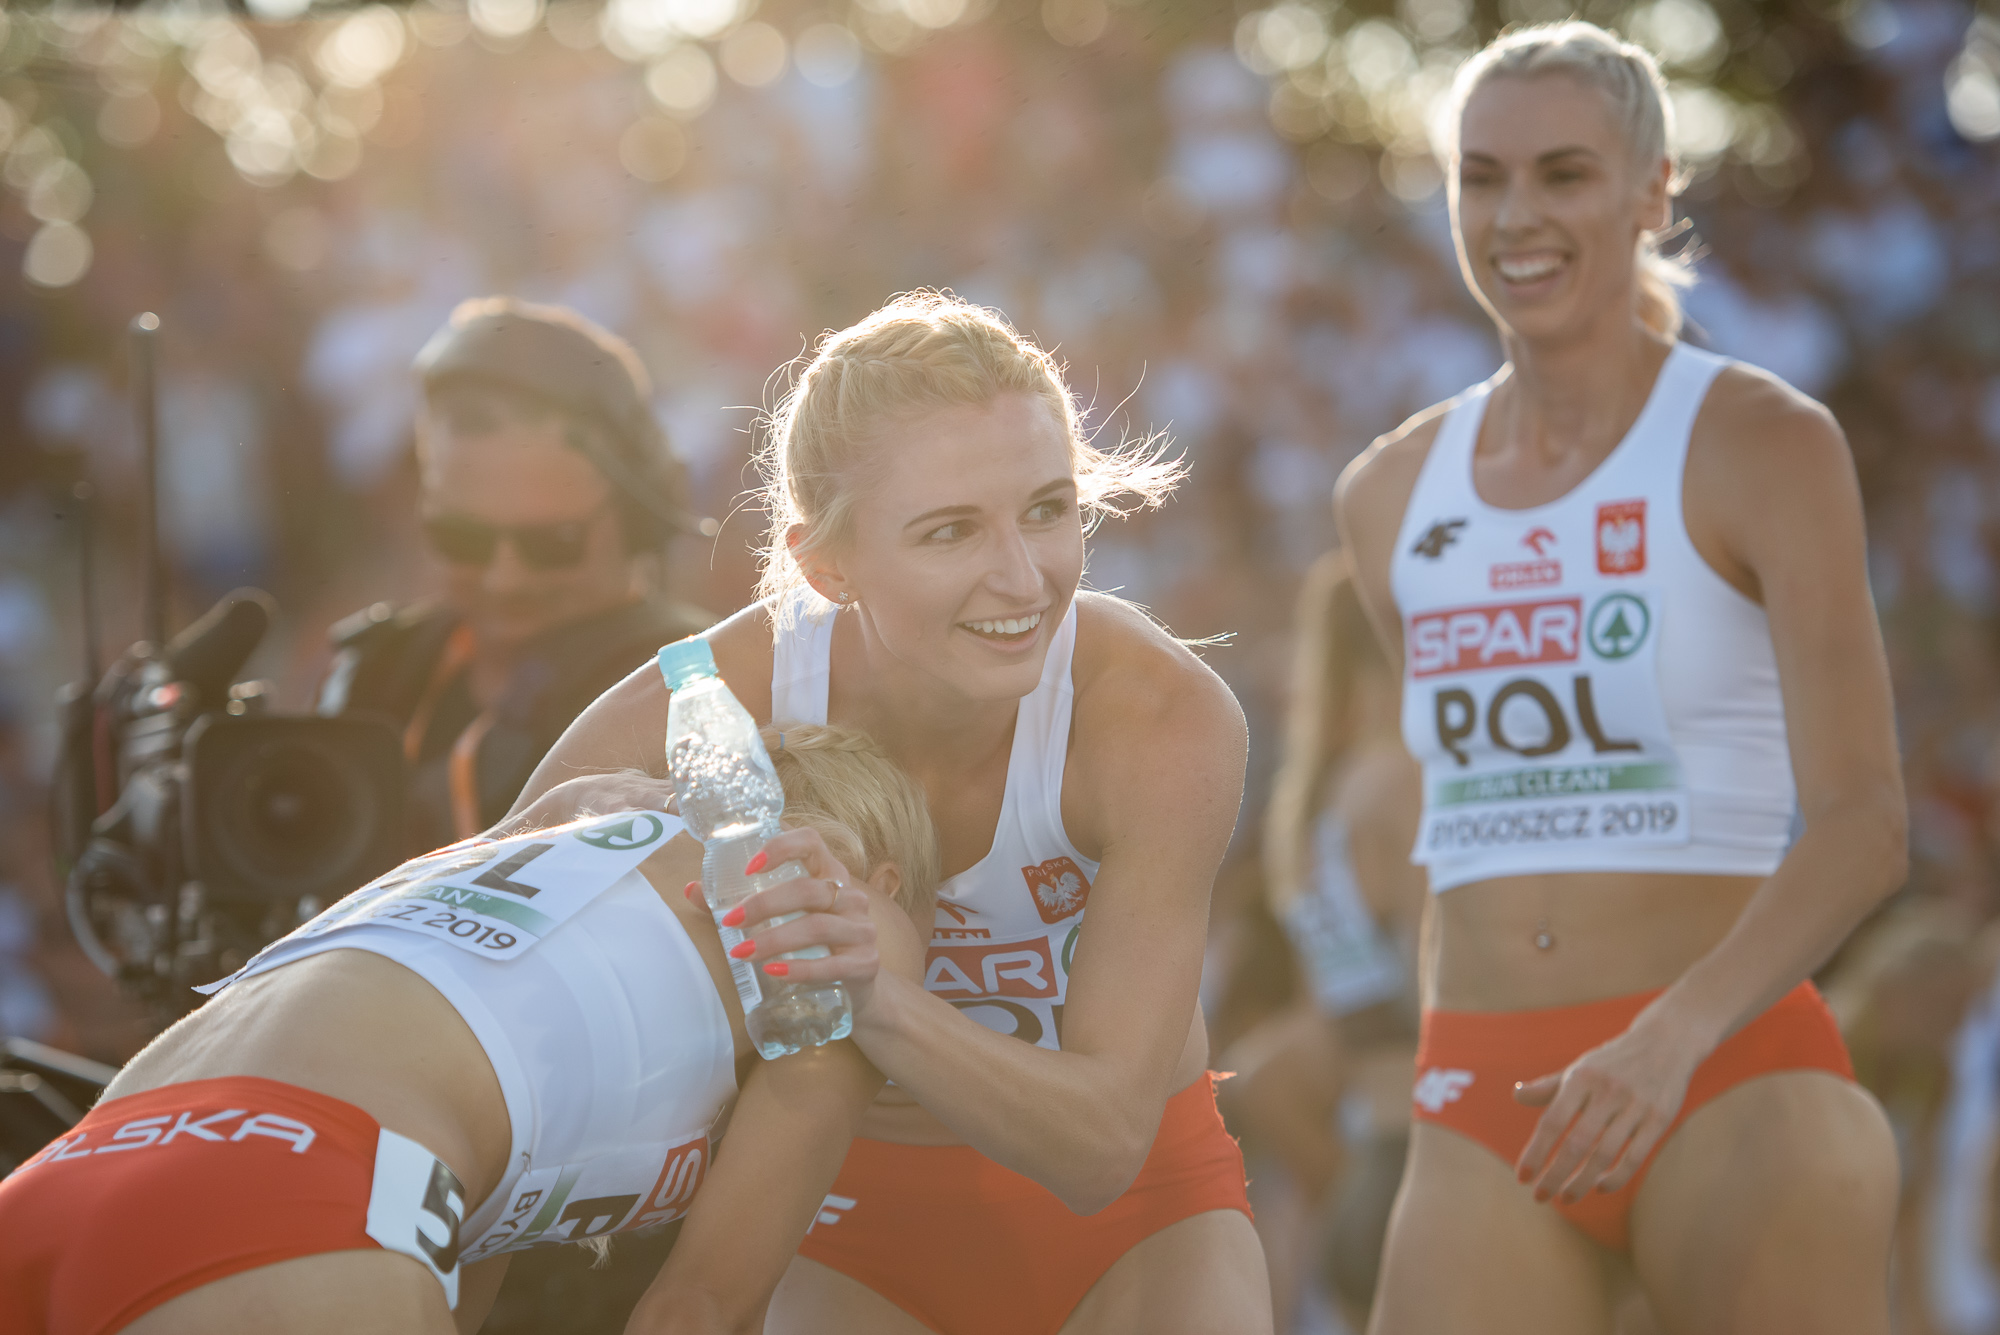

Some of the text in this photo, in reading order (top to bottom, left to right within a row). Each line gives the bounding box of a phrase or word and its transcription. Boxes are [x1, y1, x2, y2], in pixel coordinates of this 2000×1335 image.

[1413, 602, 1579, 672] SPAR
[1434, 673, 1645, 766] POL
[1601, 801, 1679, 837] 2019
[1027, 858, 1070, 877] POLSKA
[422, 912, 517, 950] 2019
[923, 950, 1049, 995] AR
[415, 1157, 466, 1275] 5
